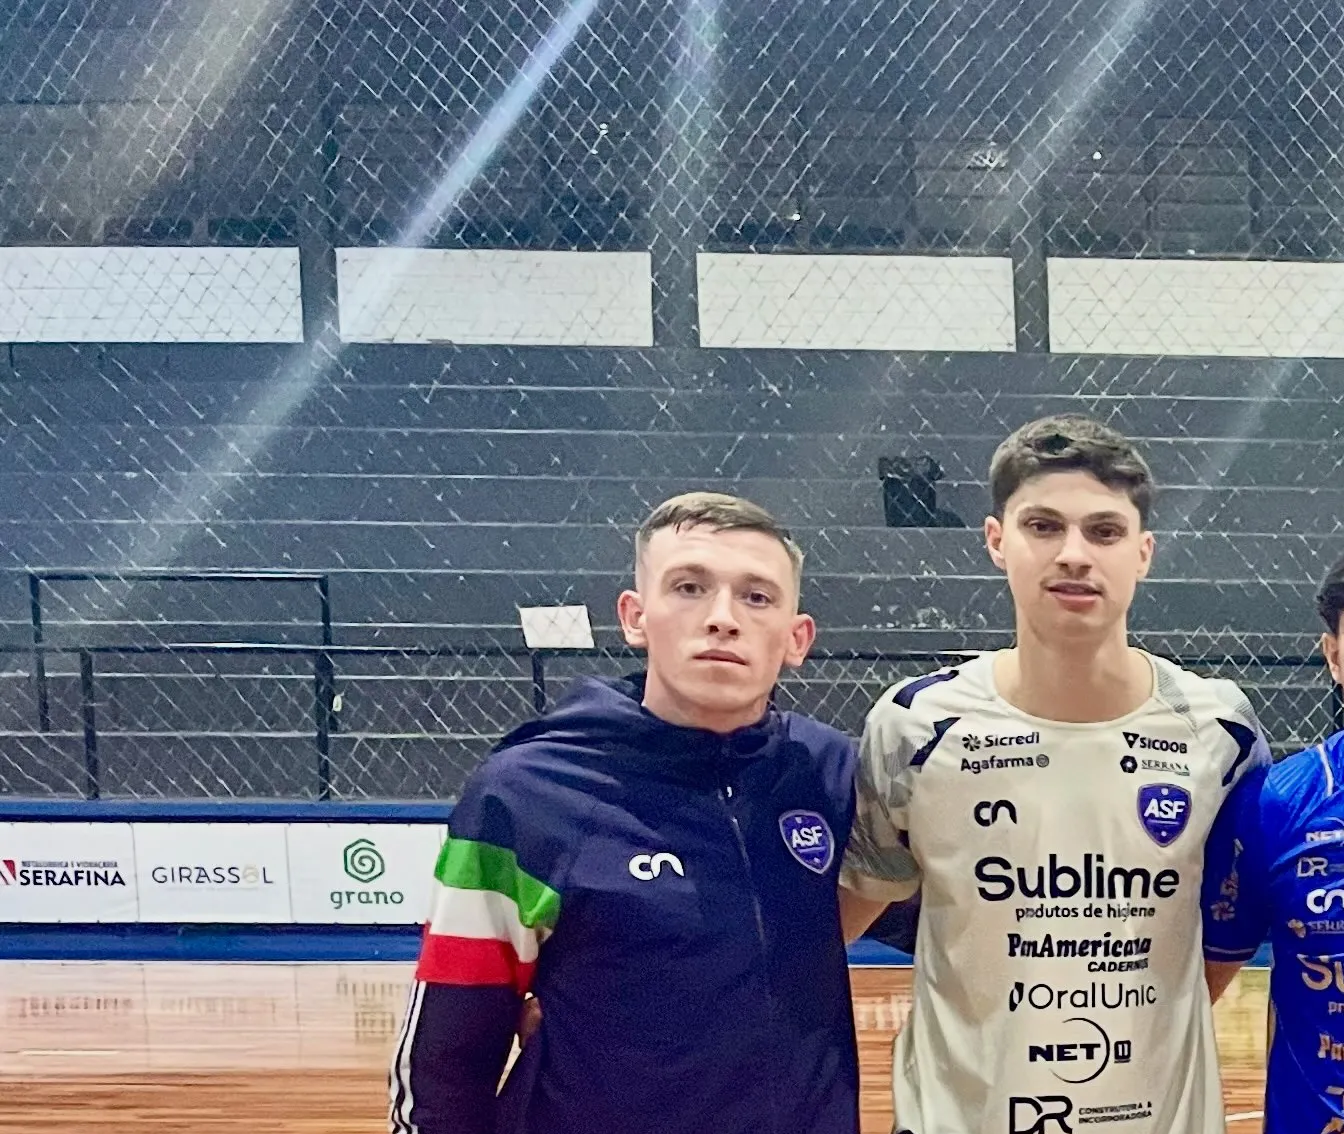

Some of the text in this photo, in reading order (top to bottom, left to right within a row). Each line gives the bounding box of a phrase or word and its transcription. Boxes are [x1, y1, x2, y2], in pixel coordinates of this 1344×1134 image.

[984, 731, 1040, 748] Sicredi
[1140, 736, 1187, 754] SICOOB
[960, 755, 1034, 774] Agafarma
[1143, 797, 1186, 821] ASF
[791, 825, 824, 848] ASF
[1296, 856, 1329, 877] DR
[19, 869, 126, 887] SERAFINA
[974, 854, 1180, 901] Sublime
[330, 889, 404, 909] grano
[1083, 904, 1103, 918] de
[1029, 1043, 1101, 1062] NET
